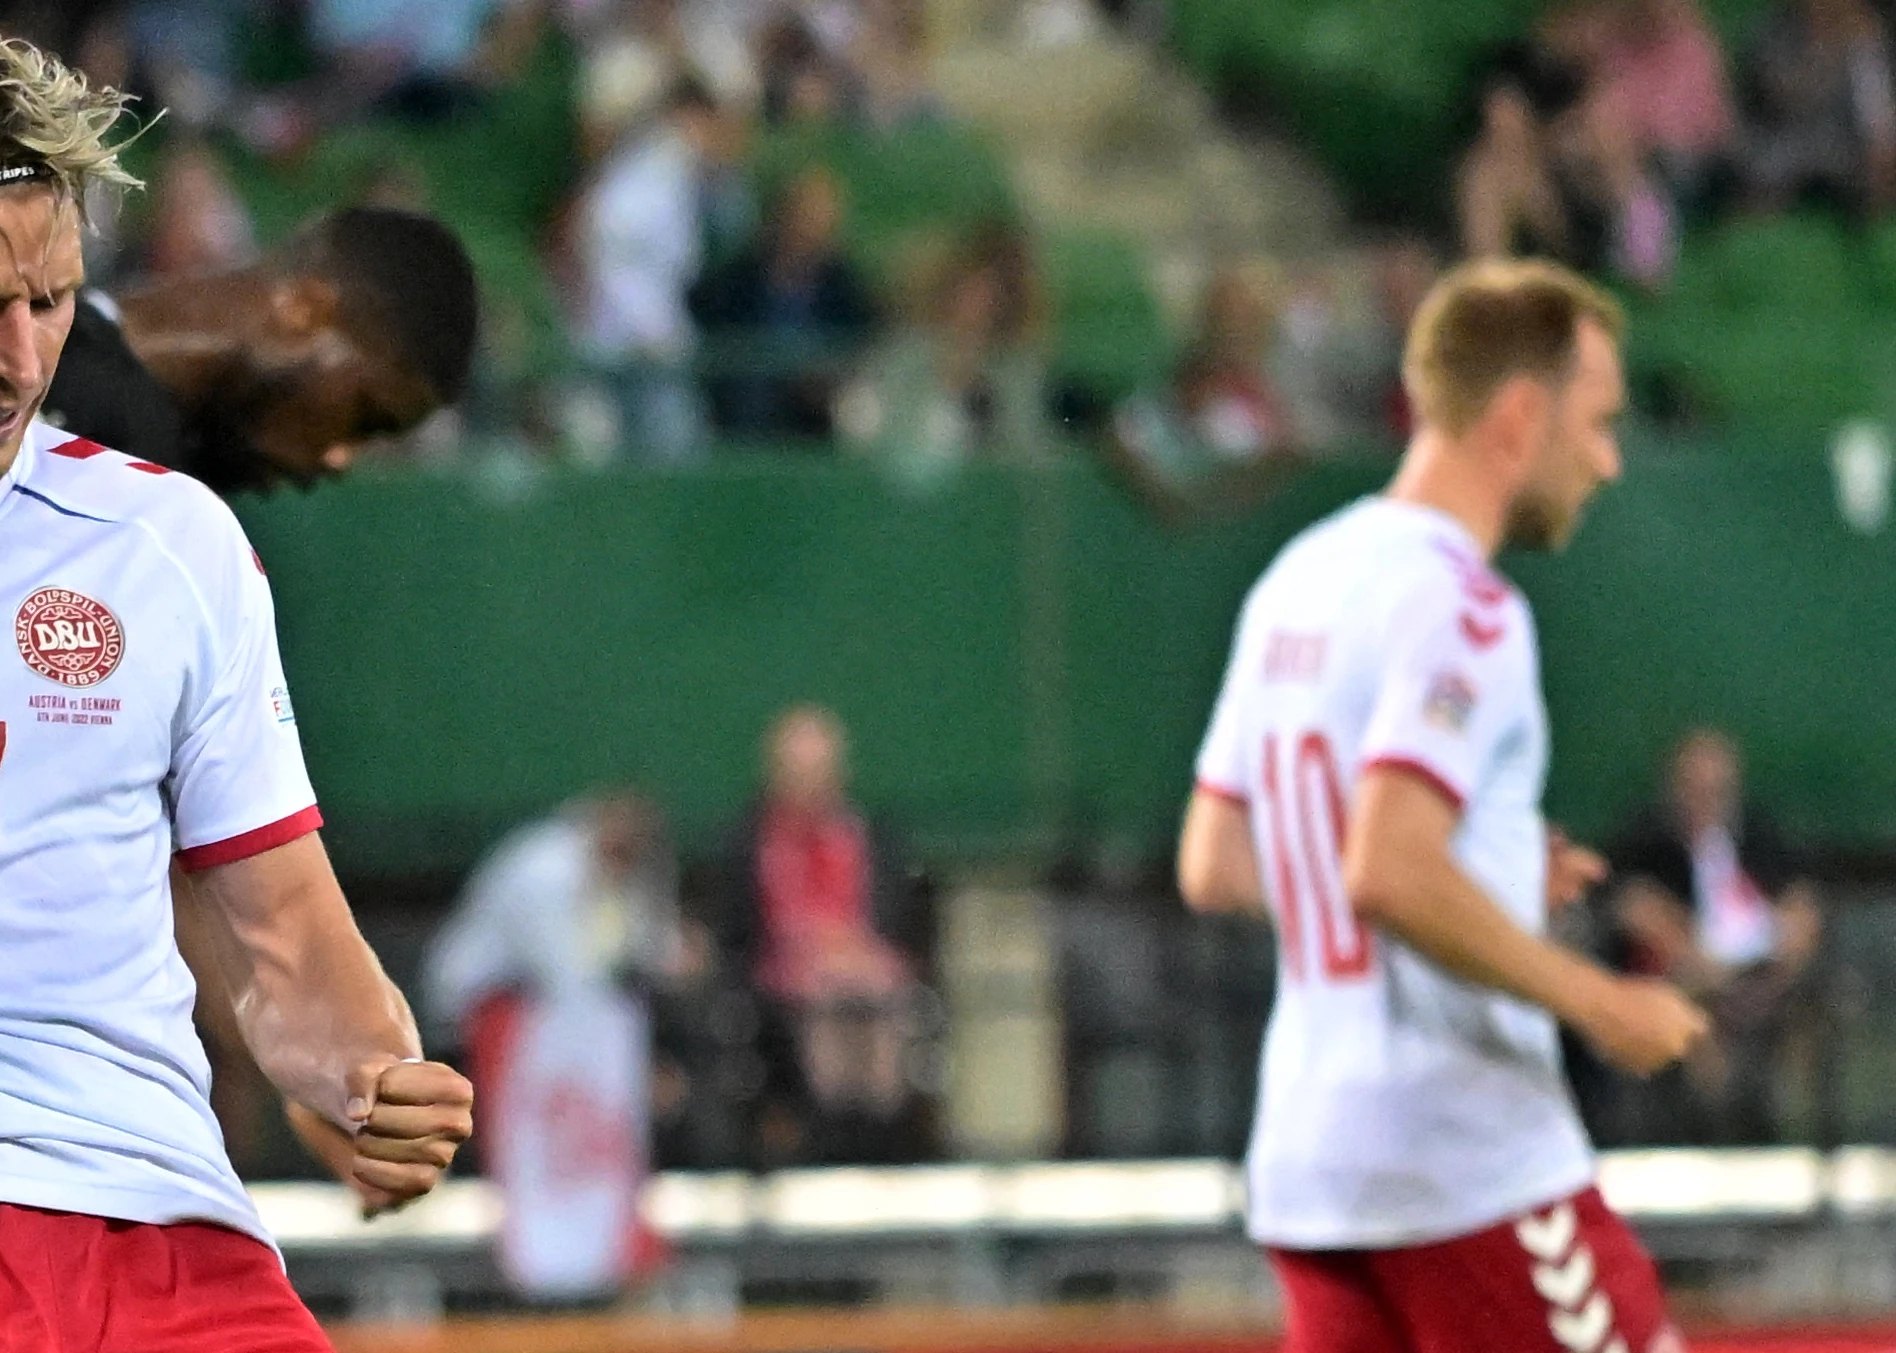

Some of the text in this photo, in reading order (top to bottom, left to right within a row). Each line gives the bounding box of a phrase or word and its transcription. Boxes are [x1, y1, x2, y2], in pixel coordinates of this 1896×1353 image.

[17, 617, 51, 674] DANSK
[99, 615, 120, 668] UNION
[34, 620, 101, 651] DBU
[58, 670, 100, 685] 1889
[29, 695, 66, 708] AUSTRIA
[81, 698, 122, 711] DENMARK
[1262, 730, 1372, 978] 10
